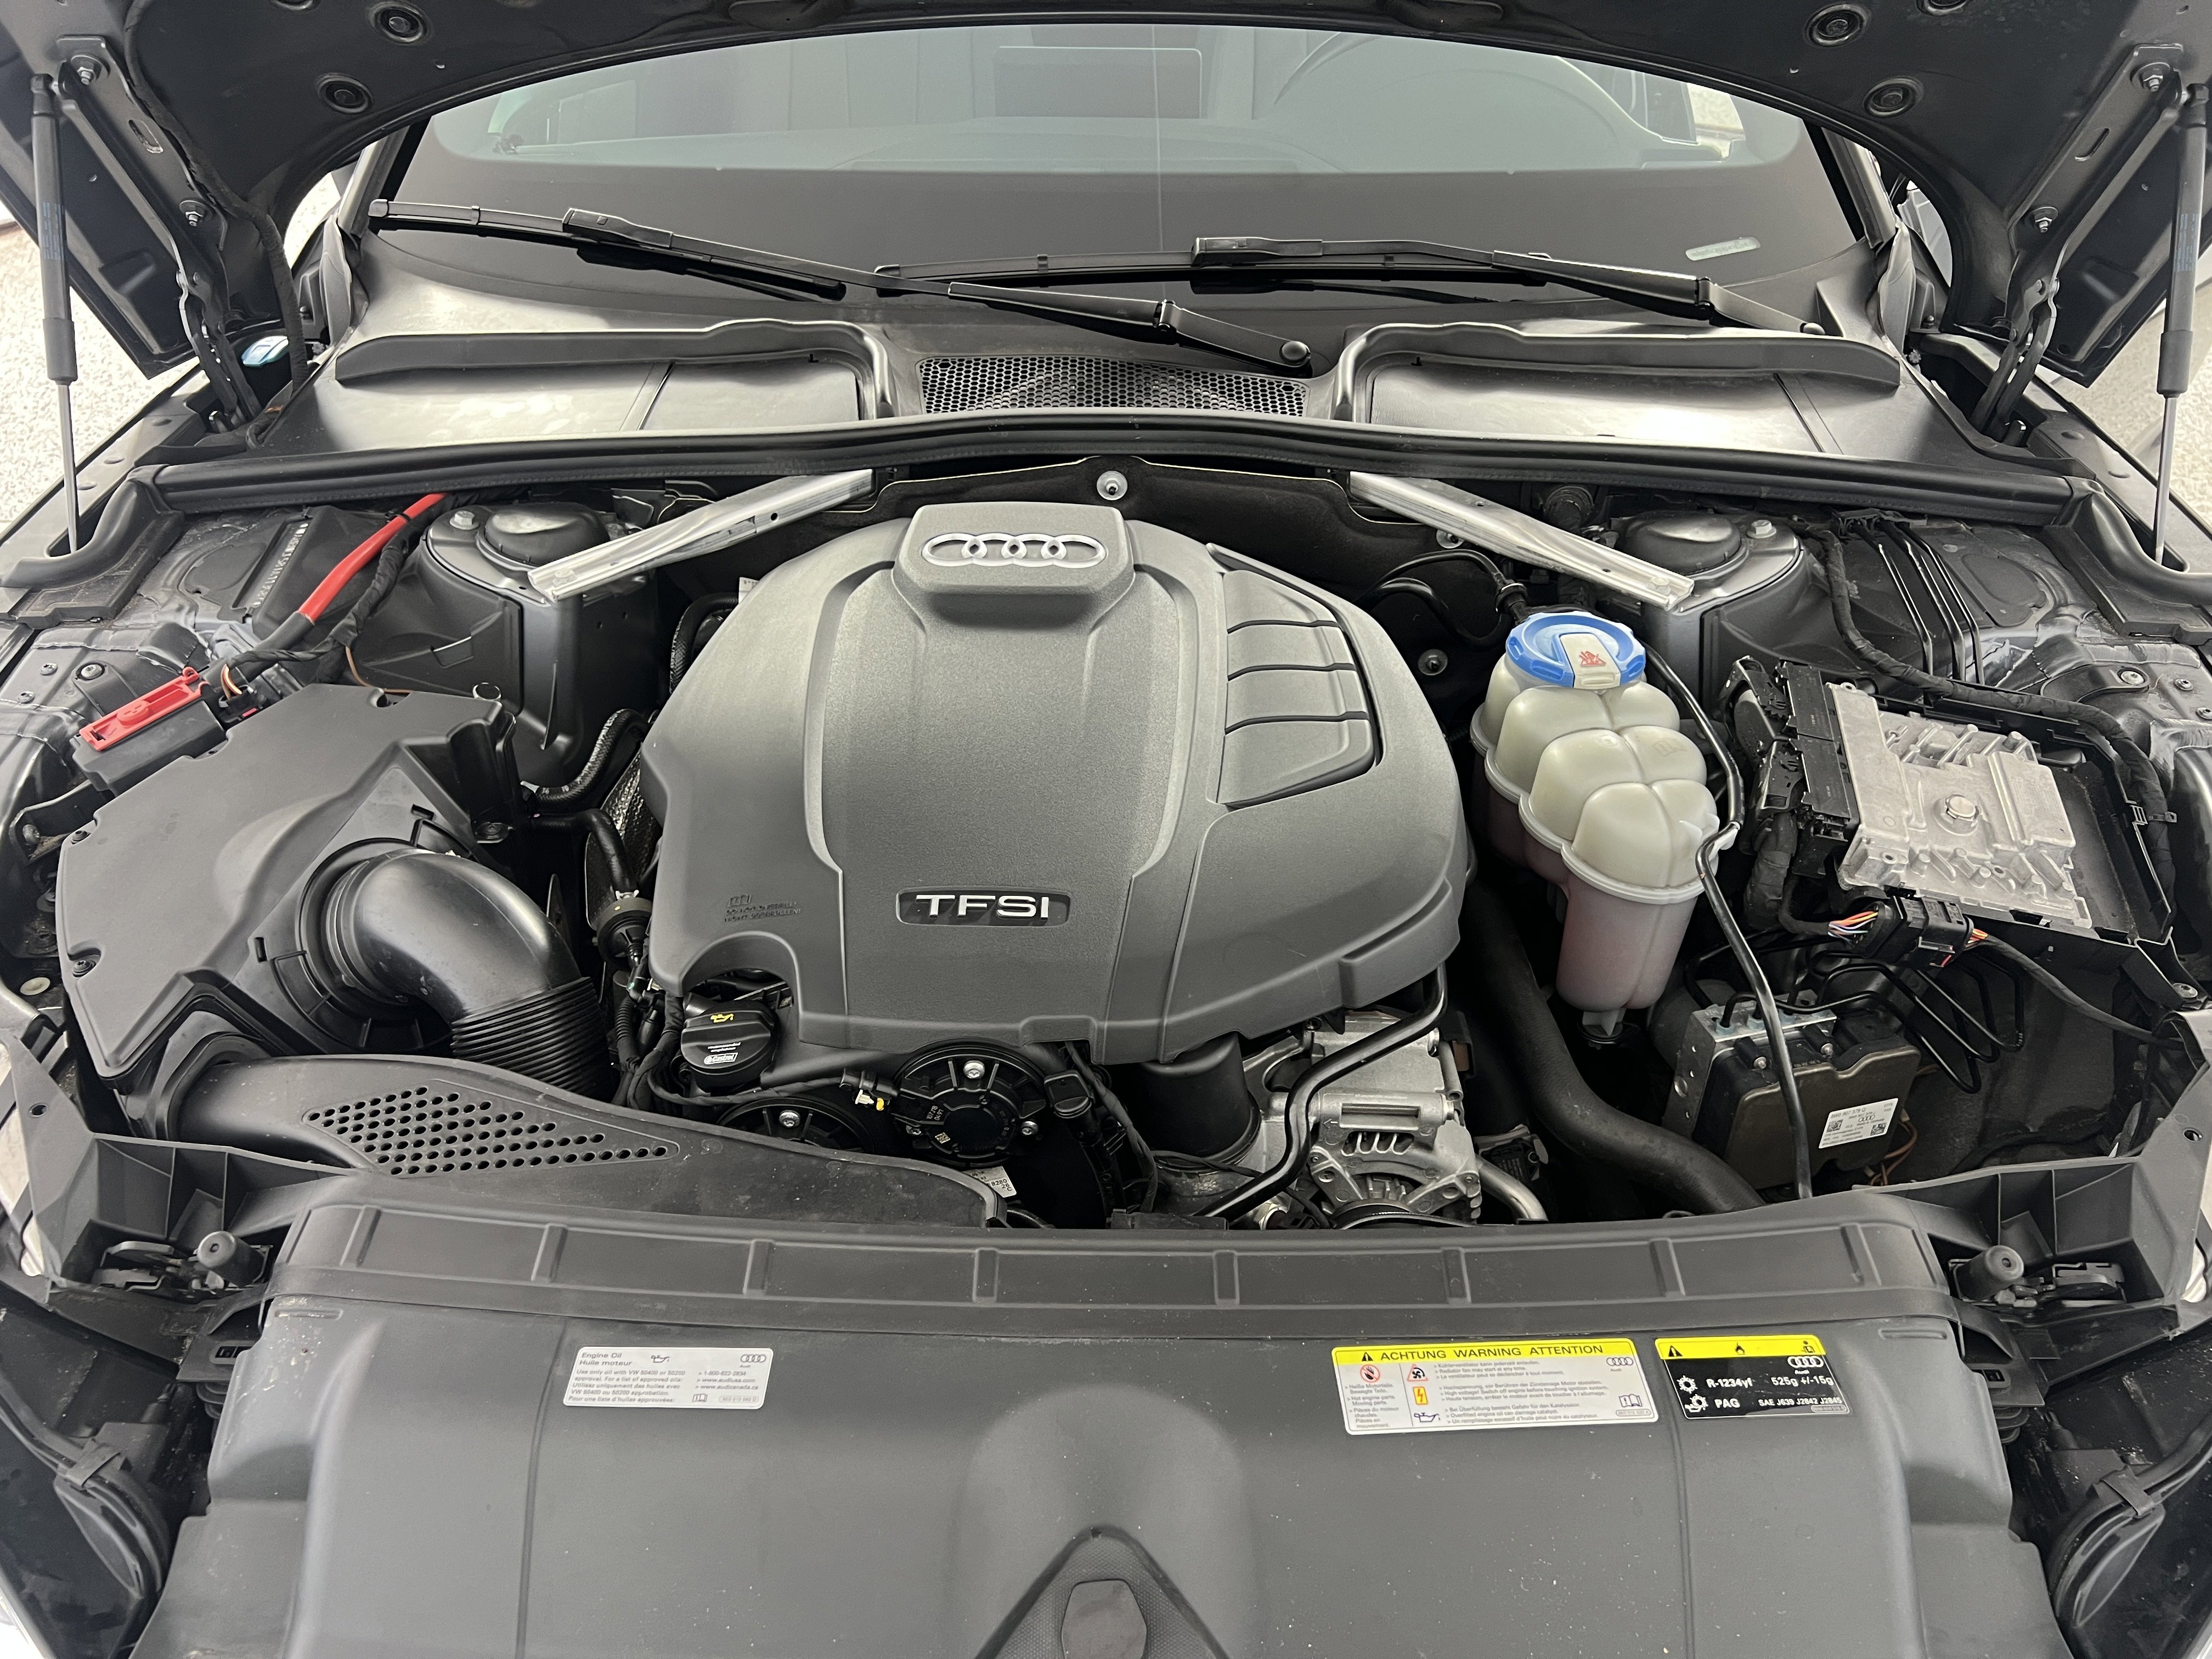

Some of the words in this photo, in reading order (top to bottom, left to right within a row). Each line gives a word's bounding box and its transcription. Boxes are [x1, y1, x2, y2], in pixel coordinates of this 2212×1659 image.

[916, 894, 1049, 919] TFSI
[1381, 1350, 1447, 1361] ACHTUNG
[1453, 1347, 1521, 1358] WARNING
[1530, 1345, 1603, 1355] ATTENTION
[1706, 1378, 1753, 1389] R-1234yf
[1771, 1376, 1799, 1387] 525g
[1800, 1375, 1834, 1386] +/-15g
[1714, 1398, 1740, 1408] PAG
